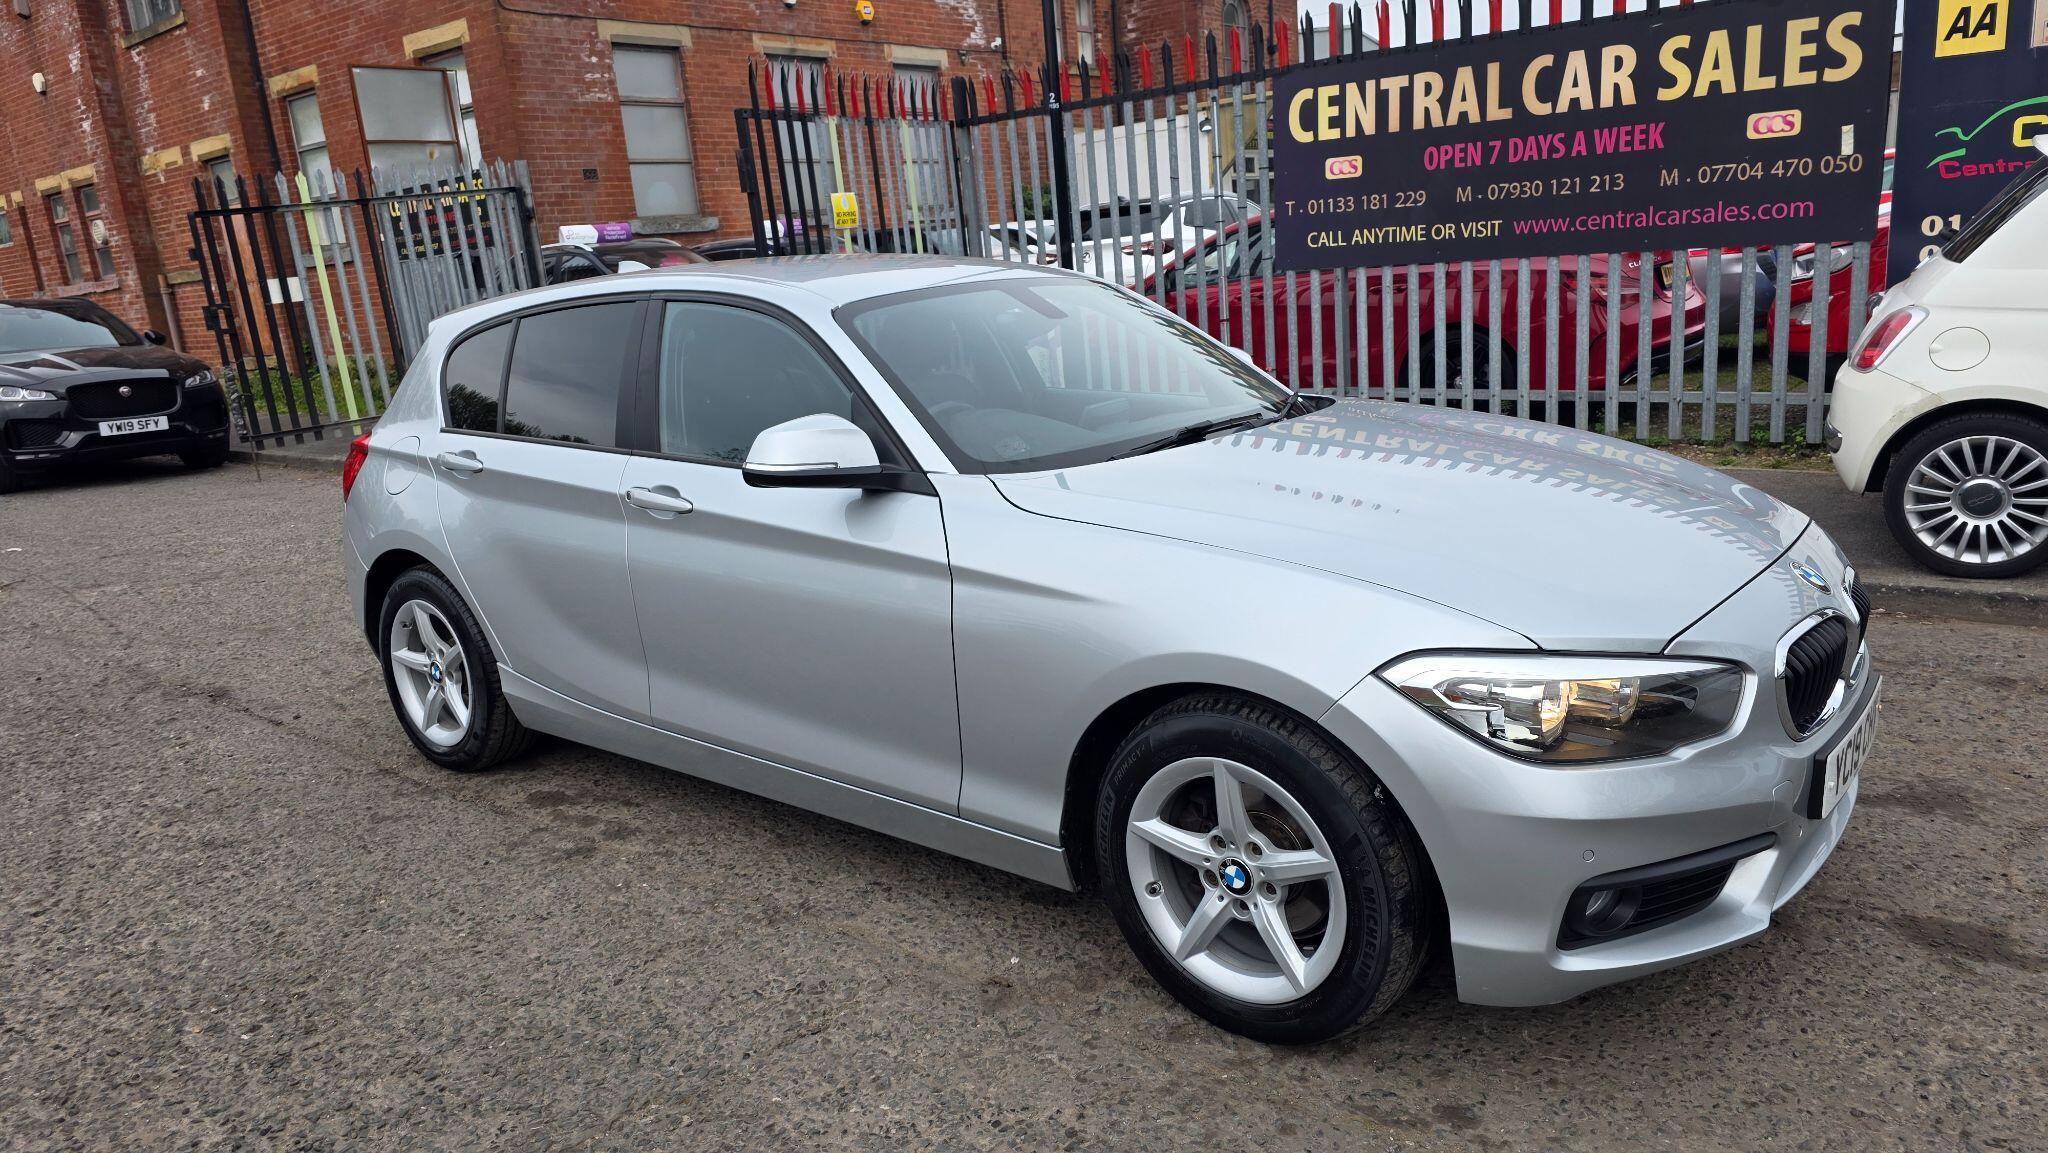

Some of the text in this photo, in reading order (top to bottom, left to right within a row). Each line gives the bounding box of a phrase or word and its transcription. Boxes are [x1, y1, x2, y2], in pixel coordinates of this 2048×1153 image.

[1943, 3, 1998, 41] AA
[1288, 11, 1863, 143] CENTRAL CAR SALES
[1049, 93, 1055, 102] 2
[1753, 114, 1796, 135] CCS
[1424, 121, 1665, 171] OPEN 7 DAYS A WEEK
[1330, 159, 1358, 176] CCS
[1698, 161, 1764, 184] 07704
[1770, 157, 1813, 178] 470
[1820, 153, 1863, 174] 050
[1488, 180, 1543, 200] 07930
[1550, 177, 1580, 195] 121
[1589, 173, 1625, 193] 213
[1308, 196, 1355, 215] 01133
[1362, 194, 1387, 210] 181
[1395, 190, 1427, 208] 229
[1307, 201, 1814, 248] CALL ANYTIME OR VISIT www.centralcarsales.com
[107, 418, 160, 433] YW19 SFY
